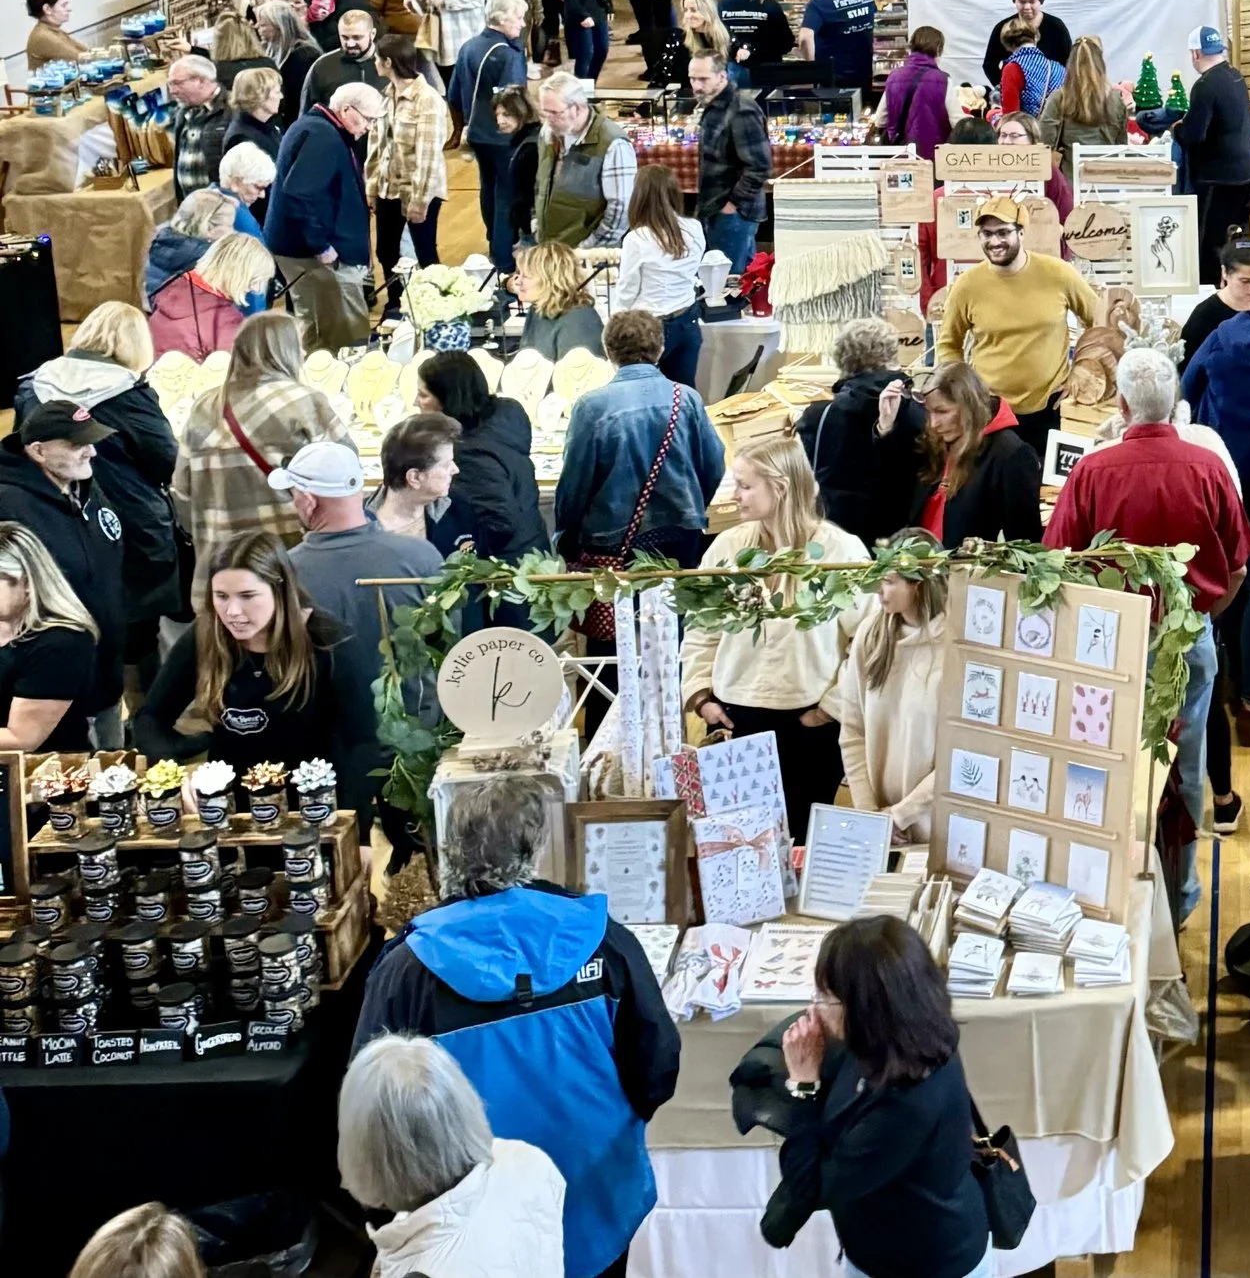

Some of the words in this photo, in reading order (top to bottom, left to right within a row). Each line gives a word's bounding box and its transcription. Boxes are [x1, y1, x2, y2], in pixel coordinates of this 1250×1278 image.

[721, 9, 768, 19] Farmhouse
[945, 152, 982, 166] GAF
[988, 152, 1041, 166] HOME
[1061, 213, 1128, 241] welcome
[445, 651, 475, 685] kylie
[477, 639, 525, 656] paper
[0, 1051, 26, 1063] TTLE
